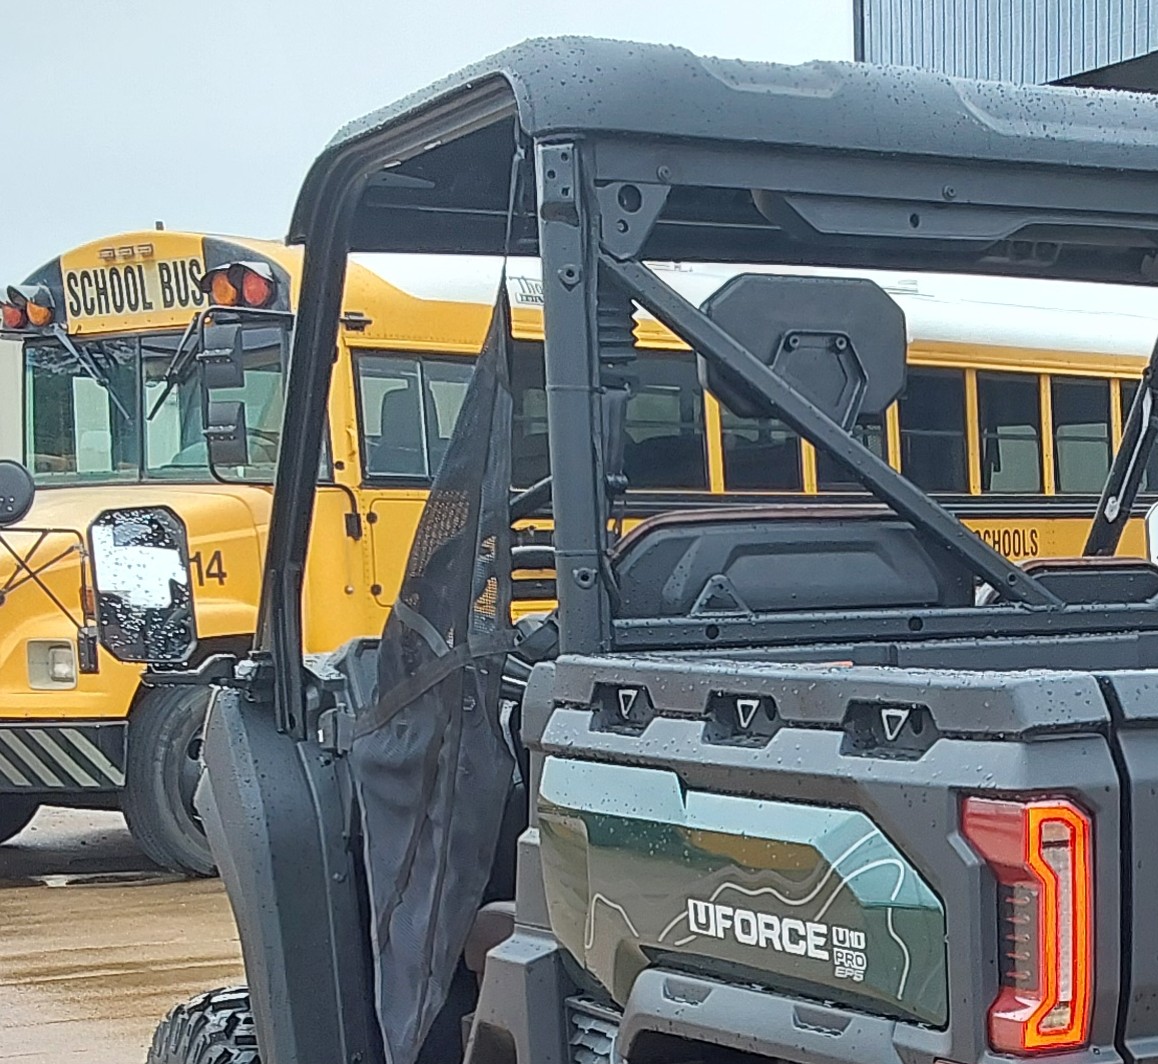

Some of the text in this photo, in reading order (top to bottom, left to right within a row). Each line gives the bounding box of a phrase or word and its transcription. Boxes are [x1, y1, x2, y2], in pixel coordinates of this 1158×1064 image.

[66, 258, 206, 318] SCHOOL BUS
[189, 549, 227, 587] 14
[687, 898, 830, 961] UFORCE
[831, 926, 867, 950] U10
[832, 947, 868, 971] PRO
[834, 967, 865, 983] EPS
